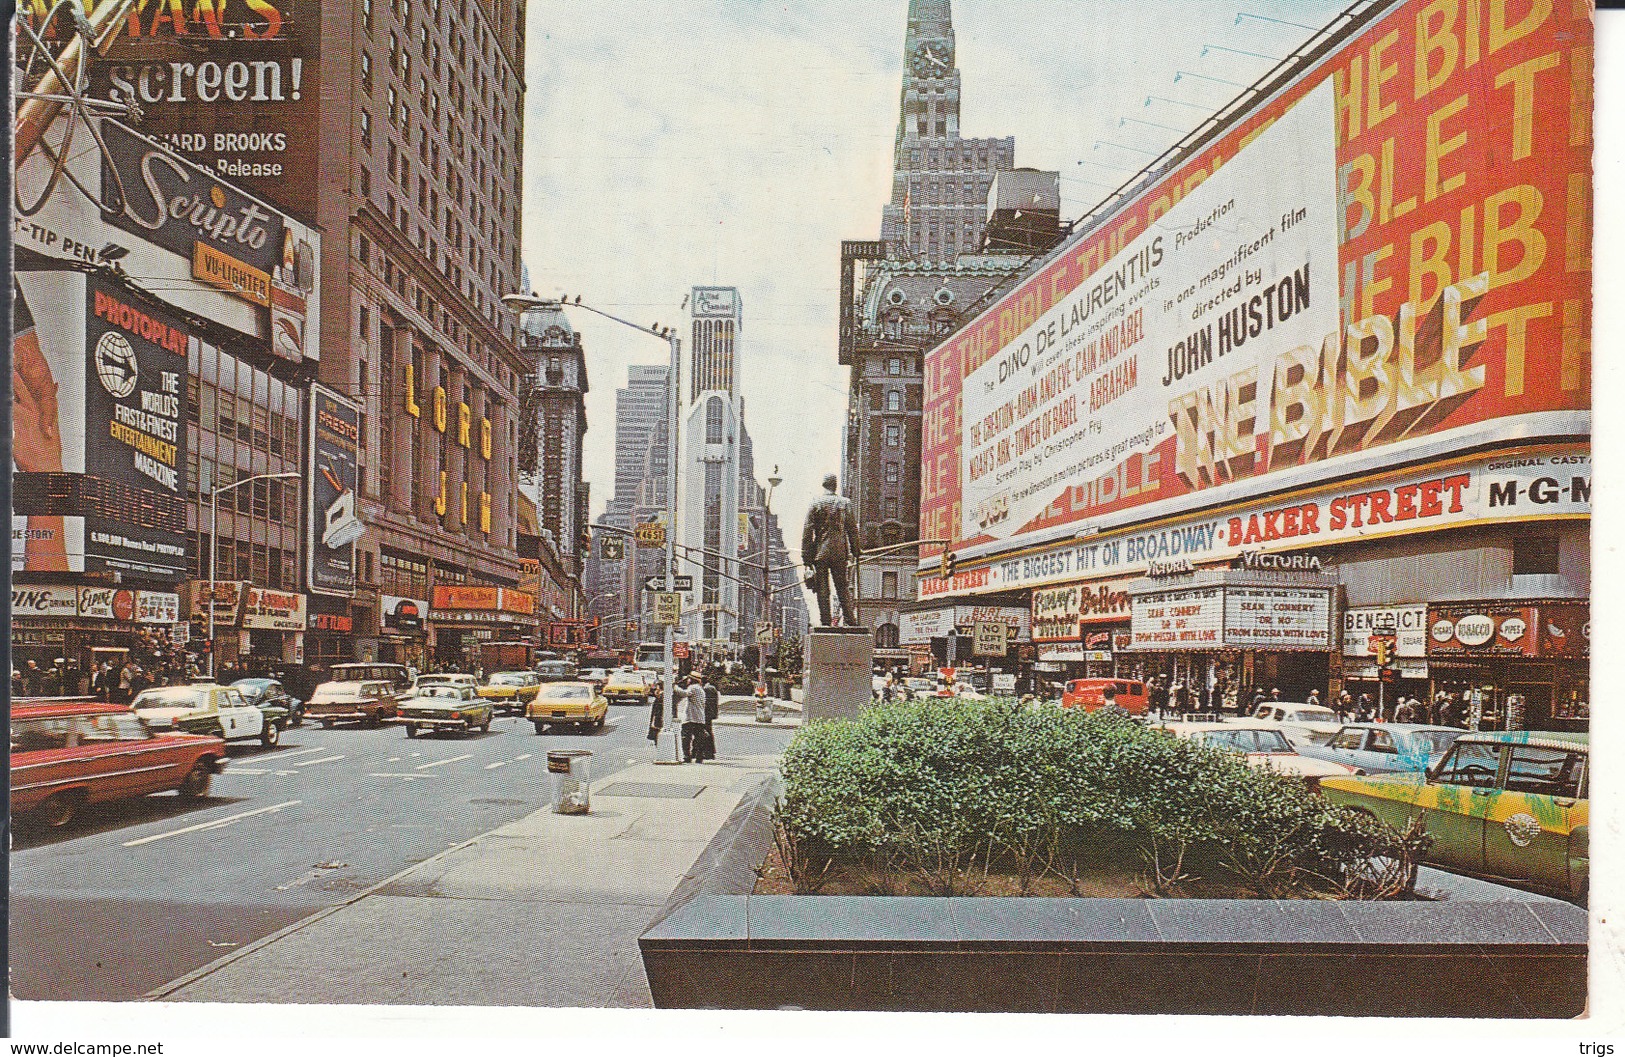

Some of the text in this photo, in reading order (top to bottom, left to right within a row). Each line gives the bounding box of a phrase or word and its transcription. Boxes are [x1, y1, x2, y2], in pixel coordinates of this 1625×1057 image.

[110, 57, 304, 103] screen!
[213, 132, 286, 152] BROOKS
[217, 159, 283, 178] Release
[128, 151, 270, 250] Scripto
[63, 238, 97, 265] PEN
[1162, 206, 1307, 313] in one magnificent film
[204, 254, 268, 300] VU-LIGHTER
[998, 197, 1235, 385] DINO DE LAURENTIIS Production
[1191, 267, 1262, 321] directed by
[94, 289, 187, 357] PHOTOPLAY
[1064, 333, 1086, 356] these
[1087, 303, 1126, 338] inspiring
[1128, 278, 1162, 307] events
[1161, 261, 1311, 387] JOHN HUSTON
[1075, 341, 1098, 383] CAIN
[1267, 270, 1489, 467] BIBLE
[161, 371, 179, 394] THE
[1088, 354, 1138, 415] ABRAHAM
[141, 390, 179, 418] WORLD'S
[405, 363, 492, 461] LORD
[110, 419, 178, 467] ENTERTAINMENT
[134, 451, 178, 493] MAGAZINE
[1487, 455, 1584, 473] ORIGINAL CAST
[920, 472, 1472, 597] BAKER STREET THE BIGGEST HIT ON BROADWAY BAKER STREET
[1147, 558, 1195, 577] VICTORIA
[660, 595, 673, 603] NO
[972, 606, 1002, 617] BURT
[1240, 602, 1315, 612] SEAN CONNERY
[982, 625, 1000, 633] NO
[1252, 628, 1282, 637] RUSSIA
[1282, 629, 1304, 638] WITH
[1345, 610, 1424, 630] BENEDICT
[1433, 626, 1453, 636] CIGARS
[1457, 623, 1491, 637] TOBACCO
[1504, 625, 1521, 635] PIPES
[979, 643, 1001, 652] TURN
